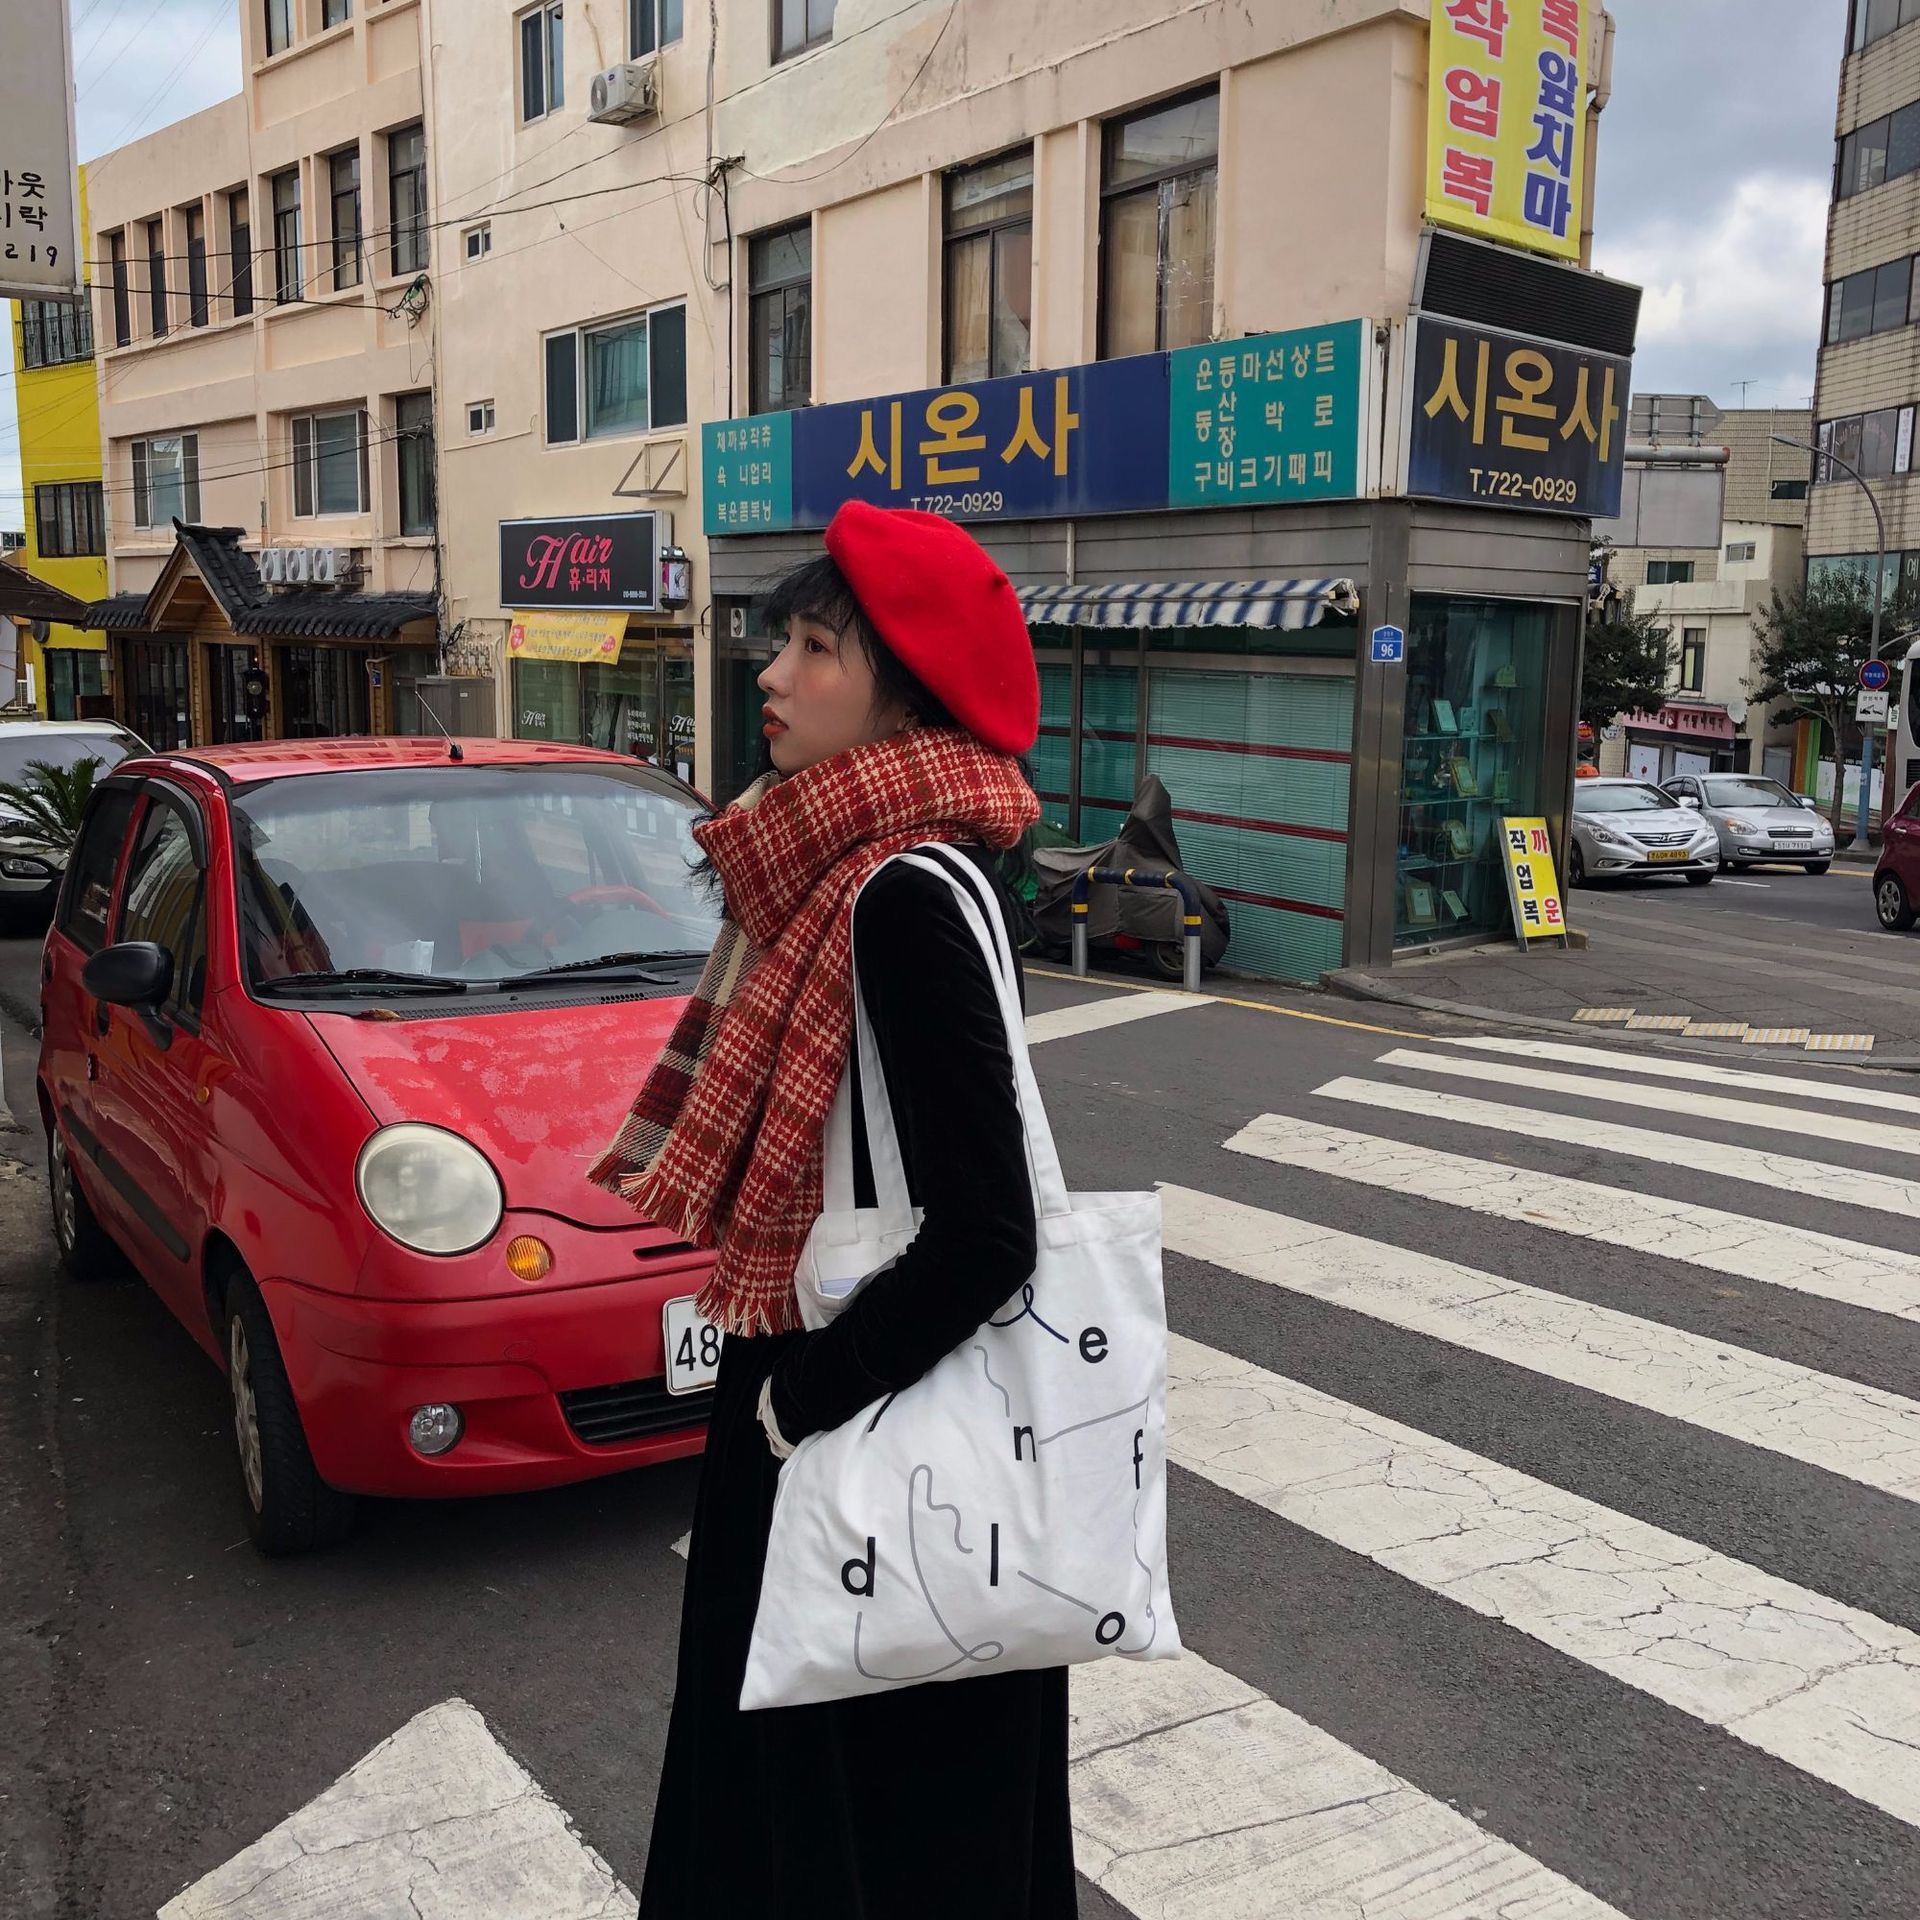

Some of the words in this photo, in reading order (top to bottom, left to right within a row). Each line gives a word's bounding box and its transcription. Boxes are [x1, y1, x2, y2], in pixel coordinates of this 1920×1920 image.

[1523, 51, 1579, 238] 앞치마
[1423, 337, 1620, 463] 시온사
[846, 375, 1080, 491] 시온사
[1469, 468, 1577, 503] T.722-0929
[519, 532, 614, 590] Hair
[1380, 643, 1394, 657] 96
[1509, 829, 1540, 925] 작업복
[1530, 828, 1561, 924] 까운
[676, 1323, 721, 1372] 48
[1079, 1326, 1109, 1364] e
[1013, 1425, 1037, 1462] n
[1132, 1428, 1144, 1490] f
[841, 1536, 876, 1598] d
[1095, 1611, 1126, 1645] o
